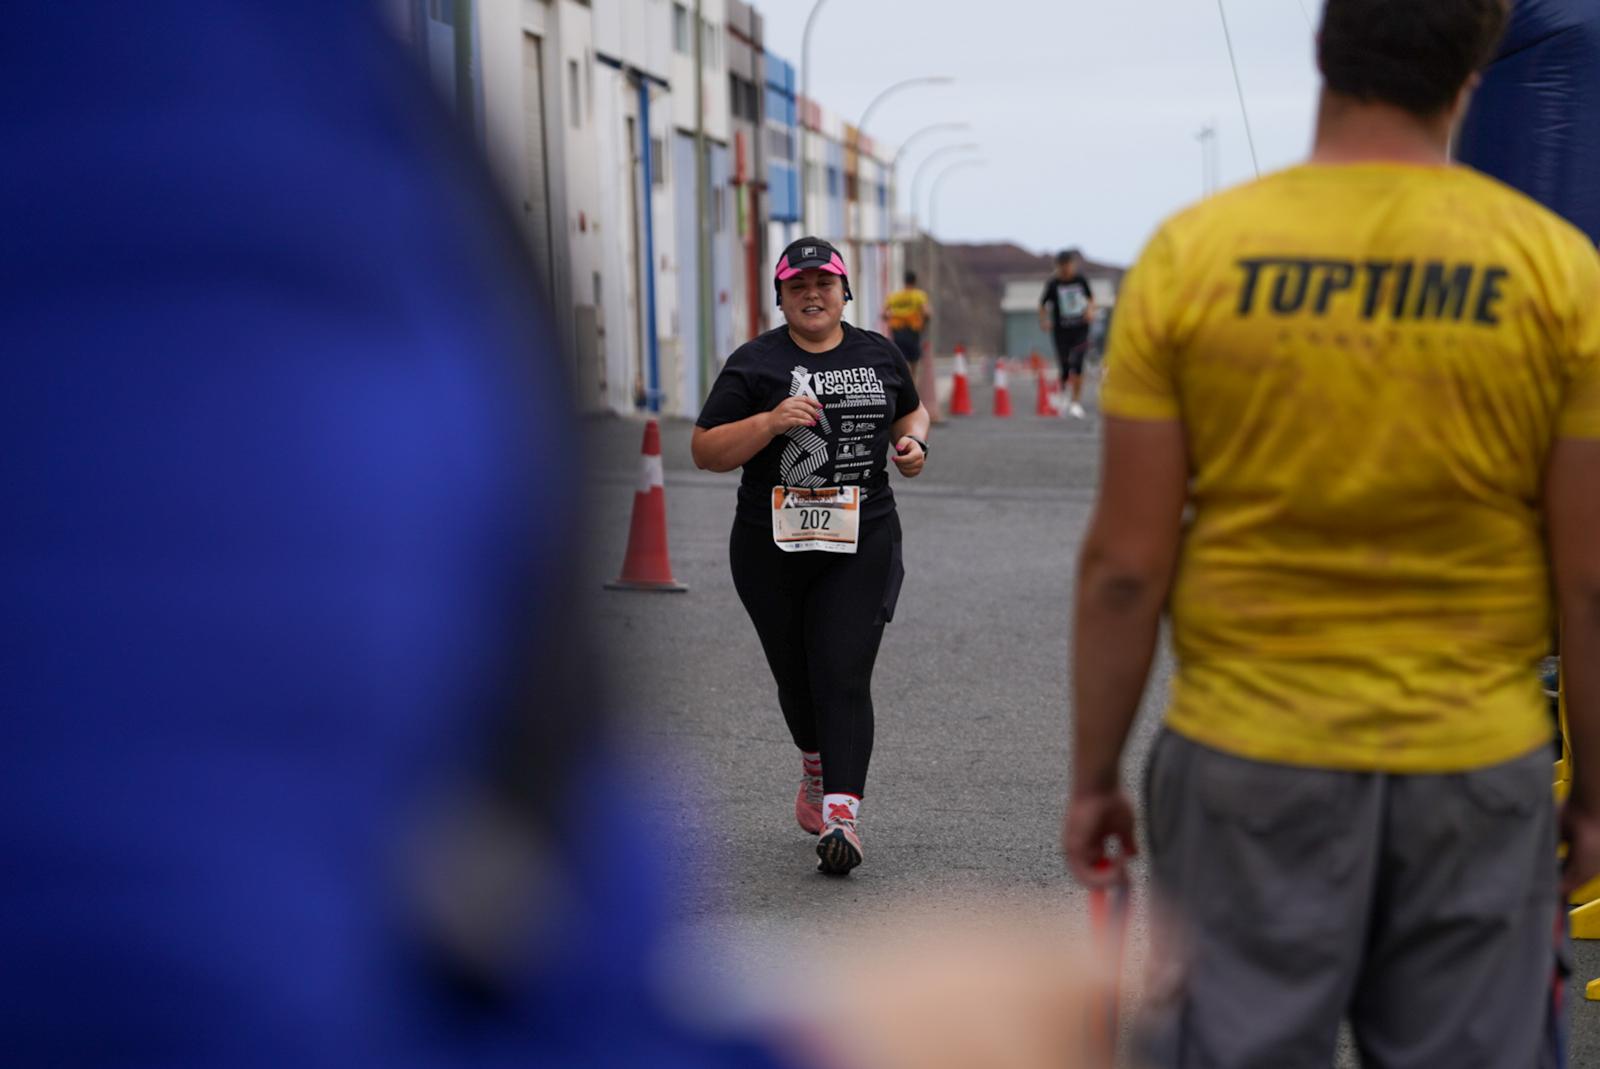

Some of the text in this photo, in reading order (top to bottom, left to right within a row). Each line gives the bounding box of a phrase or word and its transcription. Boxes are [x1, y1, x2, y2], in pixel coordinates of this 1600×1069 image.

[1237, 256, 1508, 325] TOPTIME
[816, 367, 877, 384] CARRERA
[824, 380, 885, 395] Sebadal
[800, 509, 831, 530] 202
